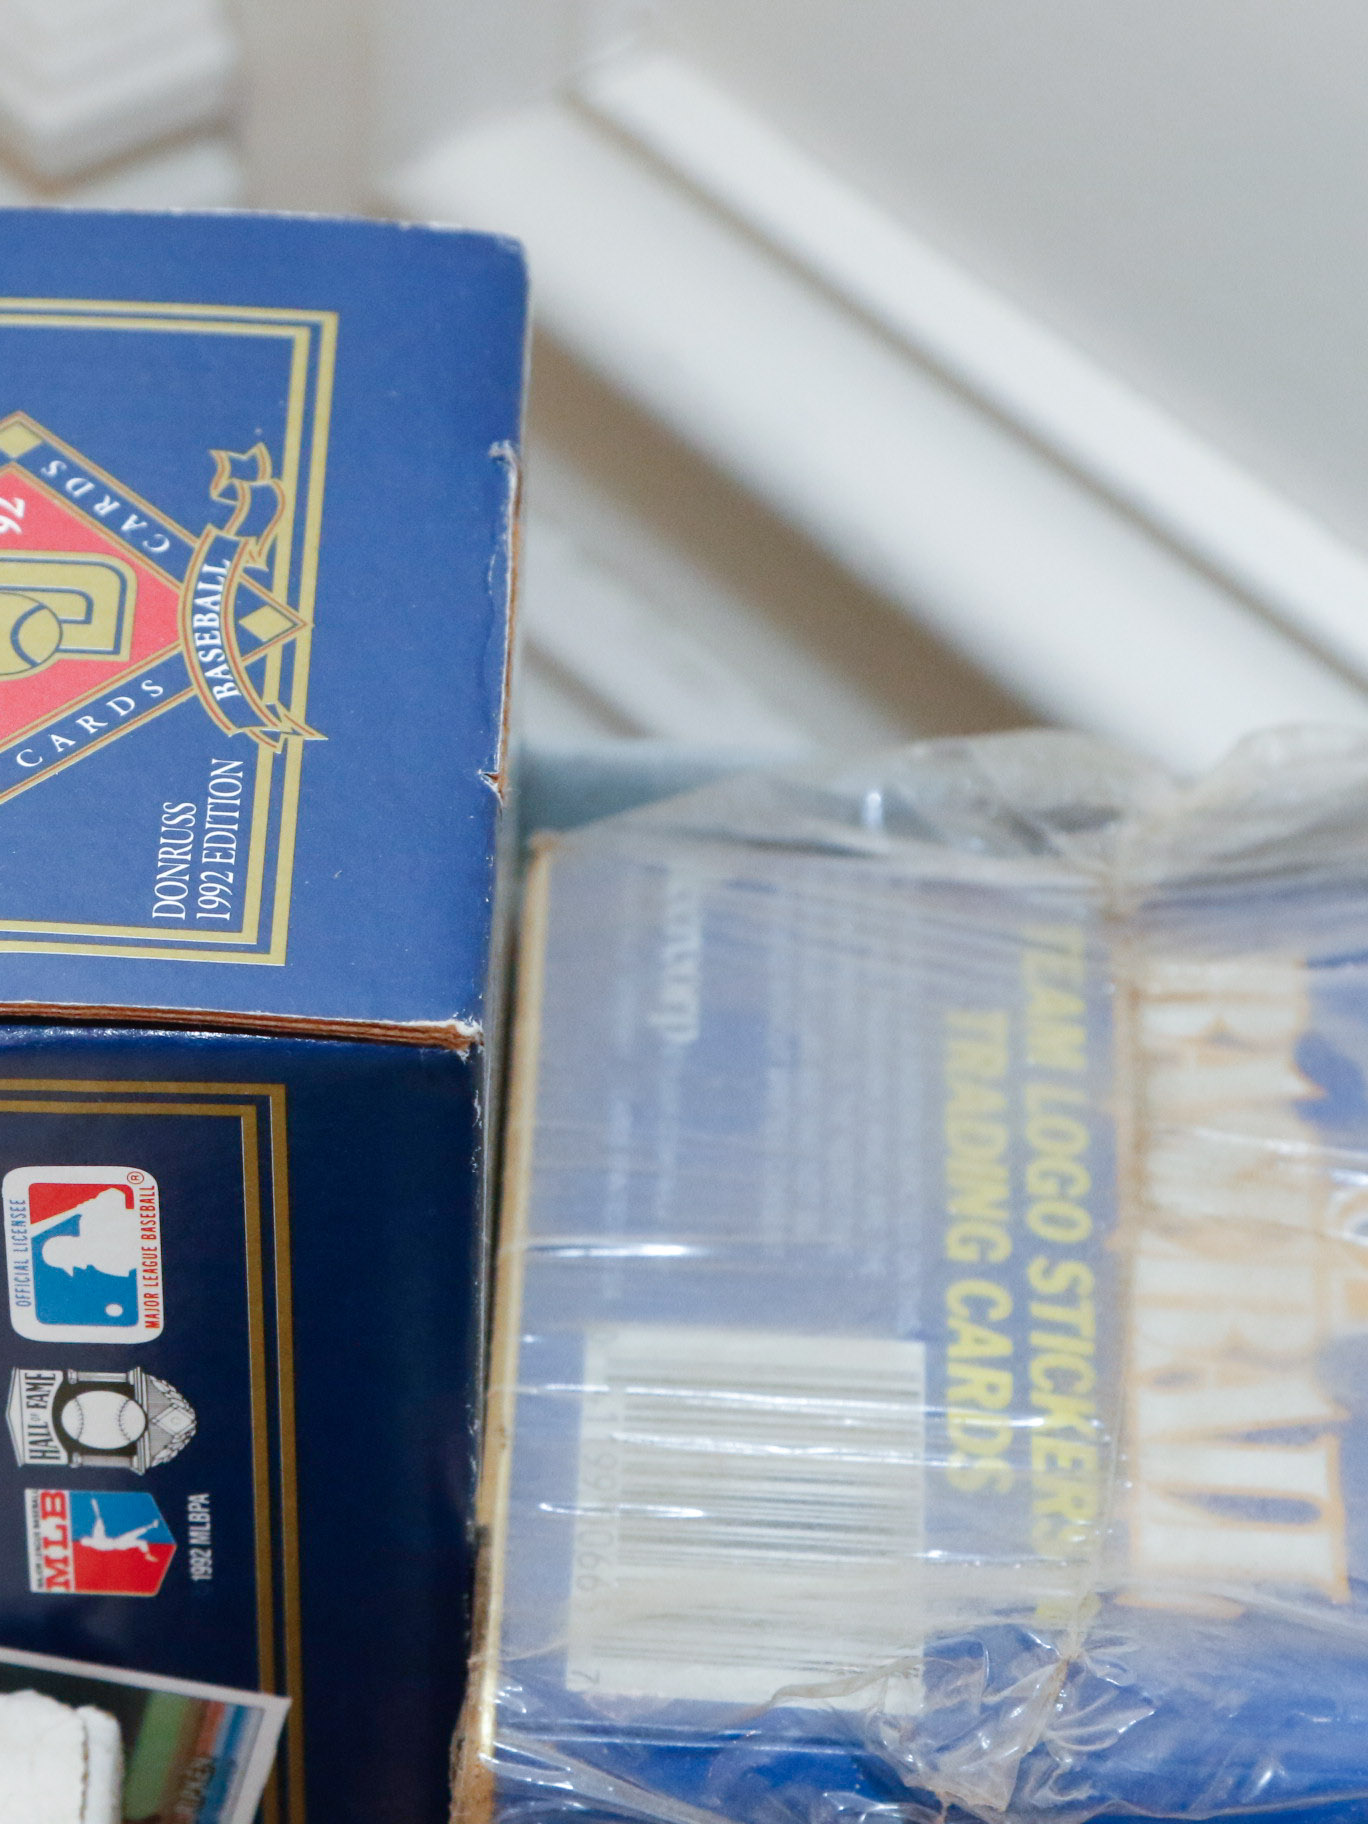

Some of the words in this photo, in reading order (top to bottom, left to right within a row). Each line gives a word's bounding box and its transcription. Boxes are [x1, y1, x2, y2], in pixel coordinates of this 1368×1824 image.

[40, 458, 172, 555] CARDS
[192, 558, 242, 700] BASEBALL
[15, 679, 164, 770] CARDS
[201, 758, 244, 866] EDITION
[151, 800, 197, 921] DONRUSS
[196, 871, 233, 921] 1992
[943, 1008, 1013, 1263] TRADING
[1022, 1082, 1093, 1243] LOGO
[9, 1198, 28, 1253] LICENSEE
[139, 1184, 156, 1243] BASEBALL
[15, 1256, 32, 1308] OFFICIAL
[142, 1245, 159, 1290] LEAGUE
[143, 1292, 160, 1330] MAJOR
[24, 1373, 56, 1410] FAME
[943, 1279, 1016, 1495] CARDS
[27, 1422, 61, 1461] HALL
[40, 1491, 70, 1592] MLB
[188, 1494, 211, 1545] MLBPA
[189, 1549, 213, 1581] 1992
